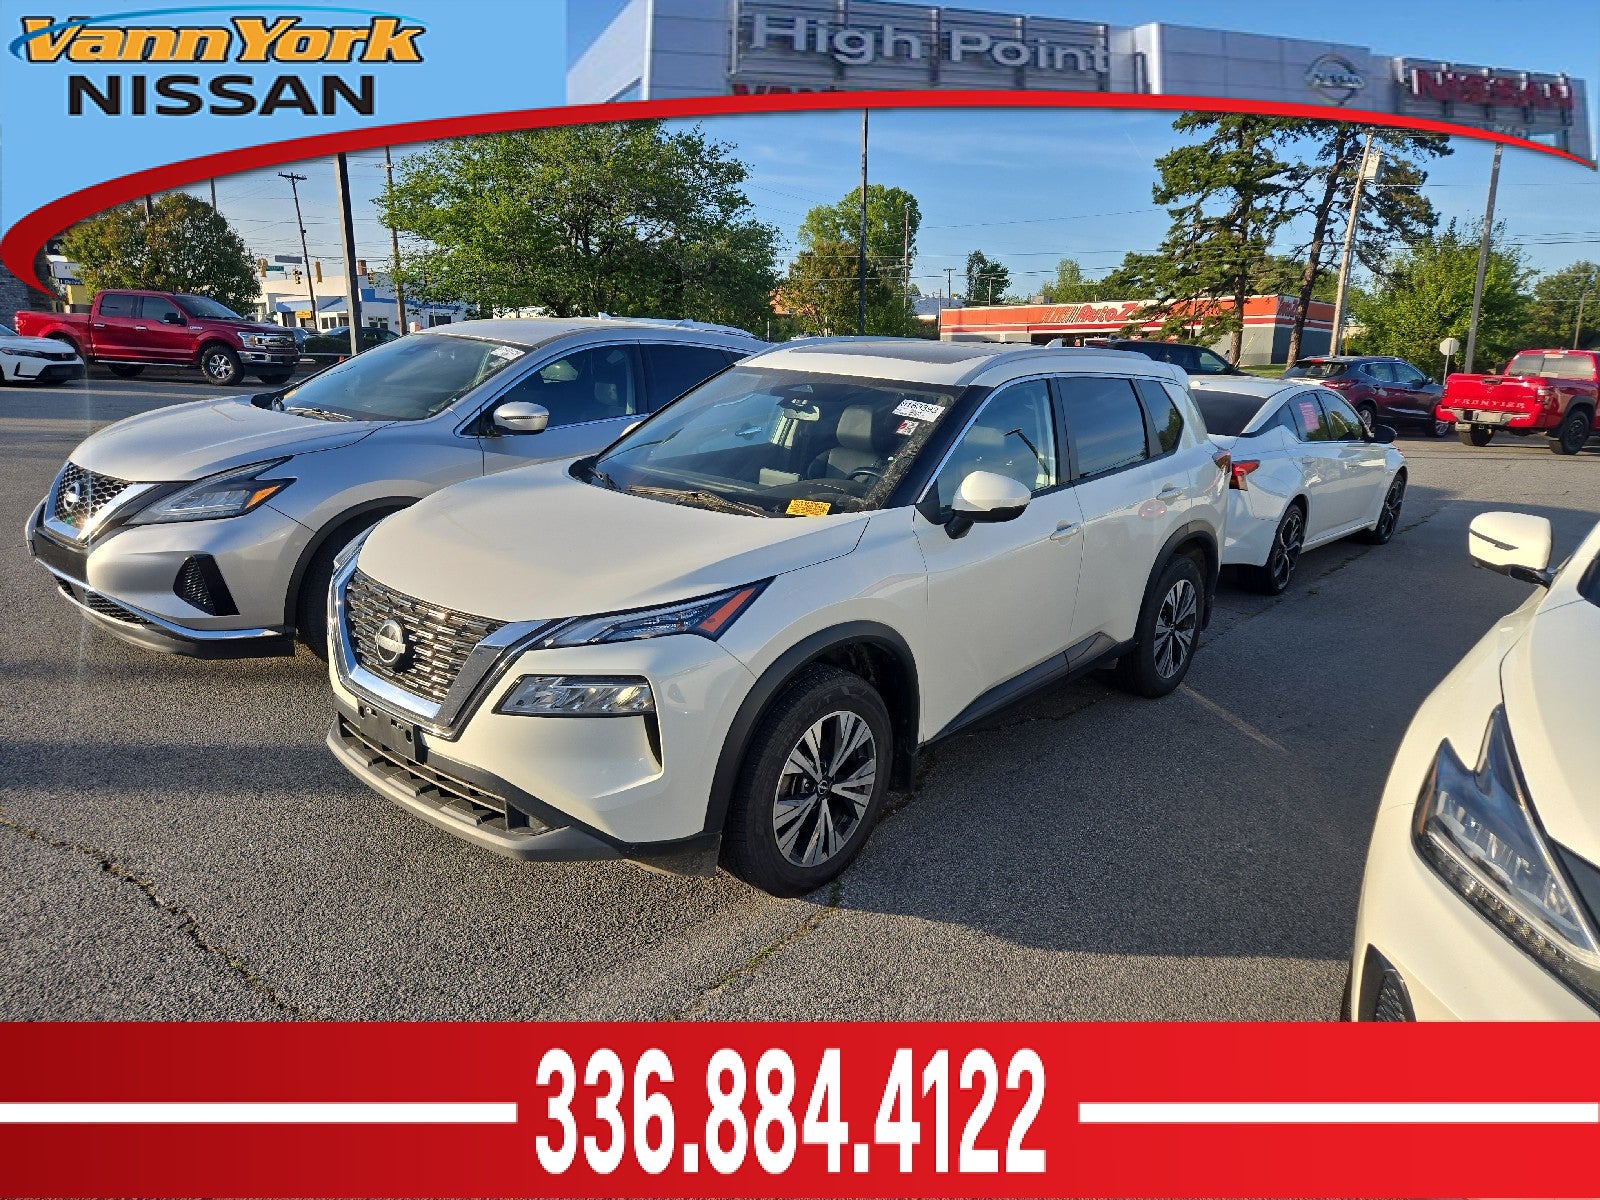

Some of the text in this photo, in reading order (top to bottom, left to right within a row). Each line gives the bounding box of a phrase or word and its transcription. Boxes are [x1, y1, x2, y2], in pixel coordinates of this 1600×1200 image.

[751, 13, 1109, 72] High Point
[1452, 398, 1526, 409] FRONTIER
